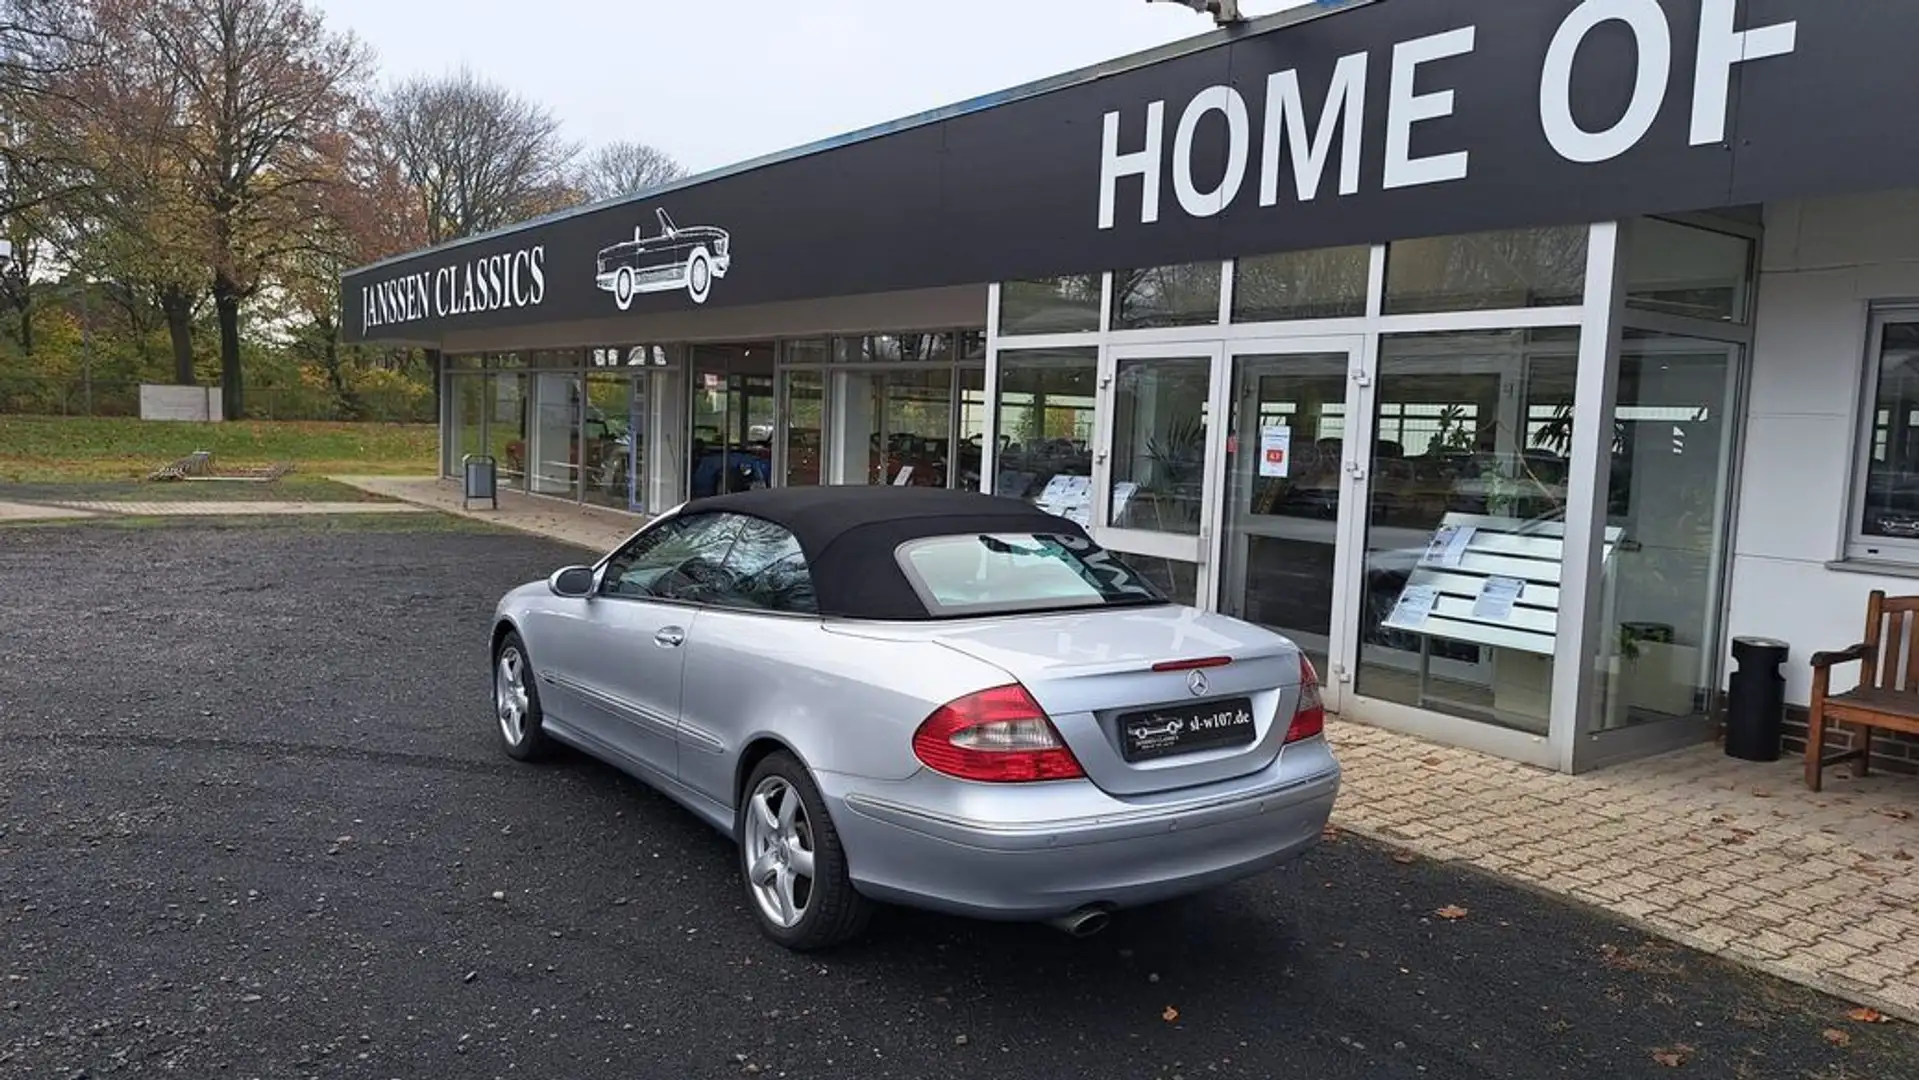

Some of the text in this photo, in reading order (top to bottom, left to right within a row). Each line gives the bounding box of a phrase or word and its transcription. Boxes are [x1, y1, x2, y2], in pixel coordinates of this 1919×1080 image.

[1098, 26, 1476, 229] HOME
[362, 246, 545, 335] JANSSEN CLASSICS
[1190, 709, 1250, 731] sl-w107.de
